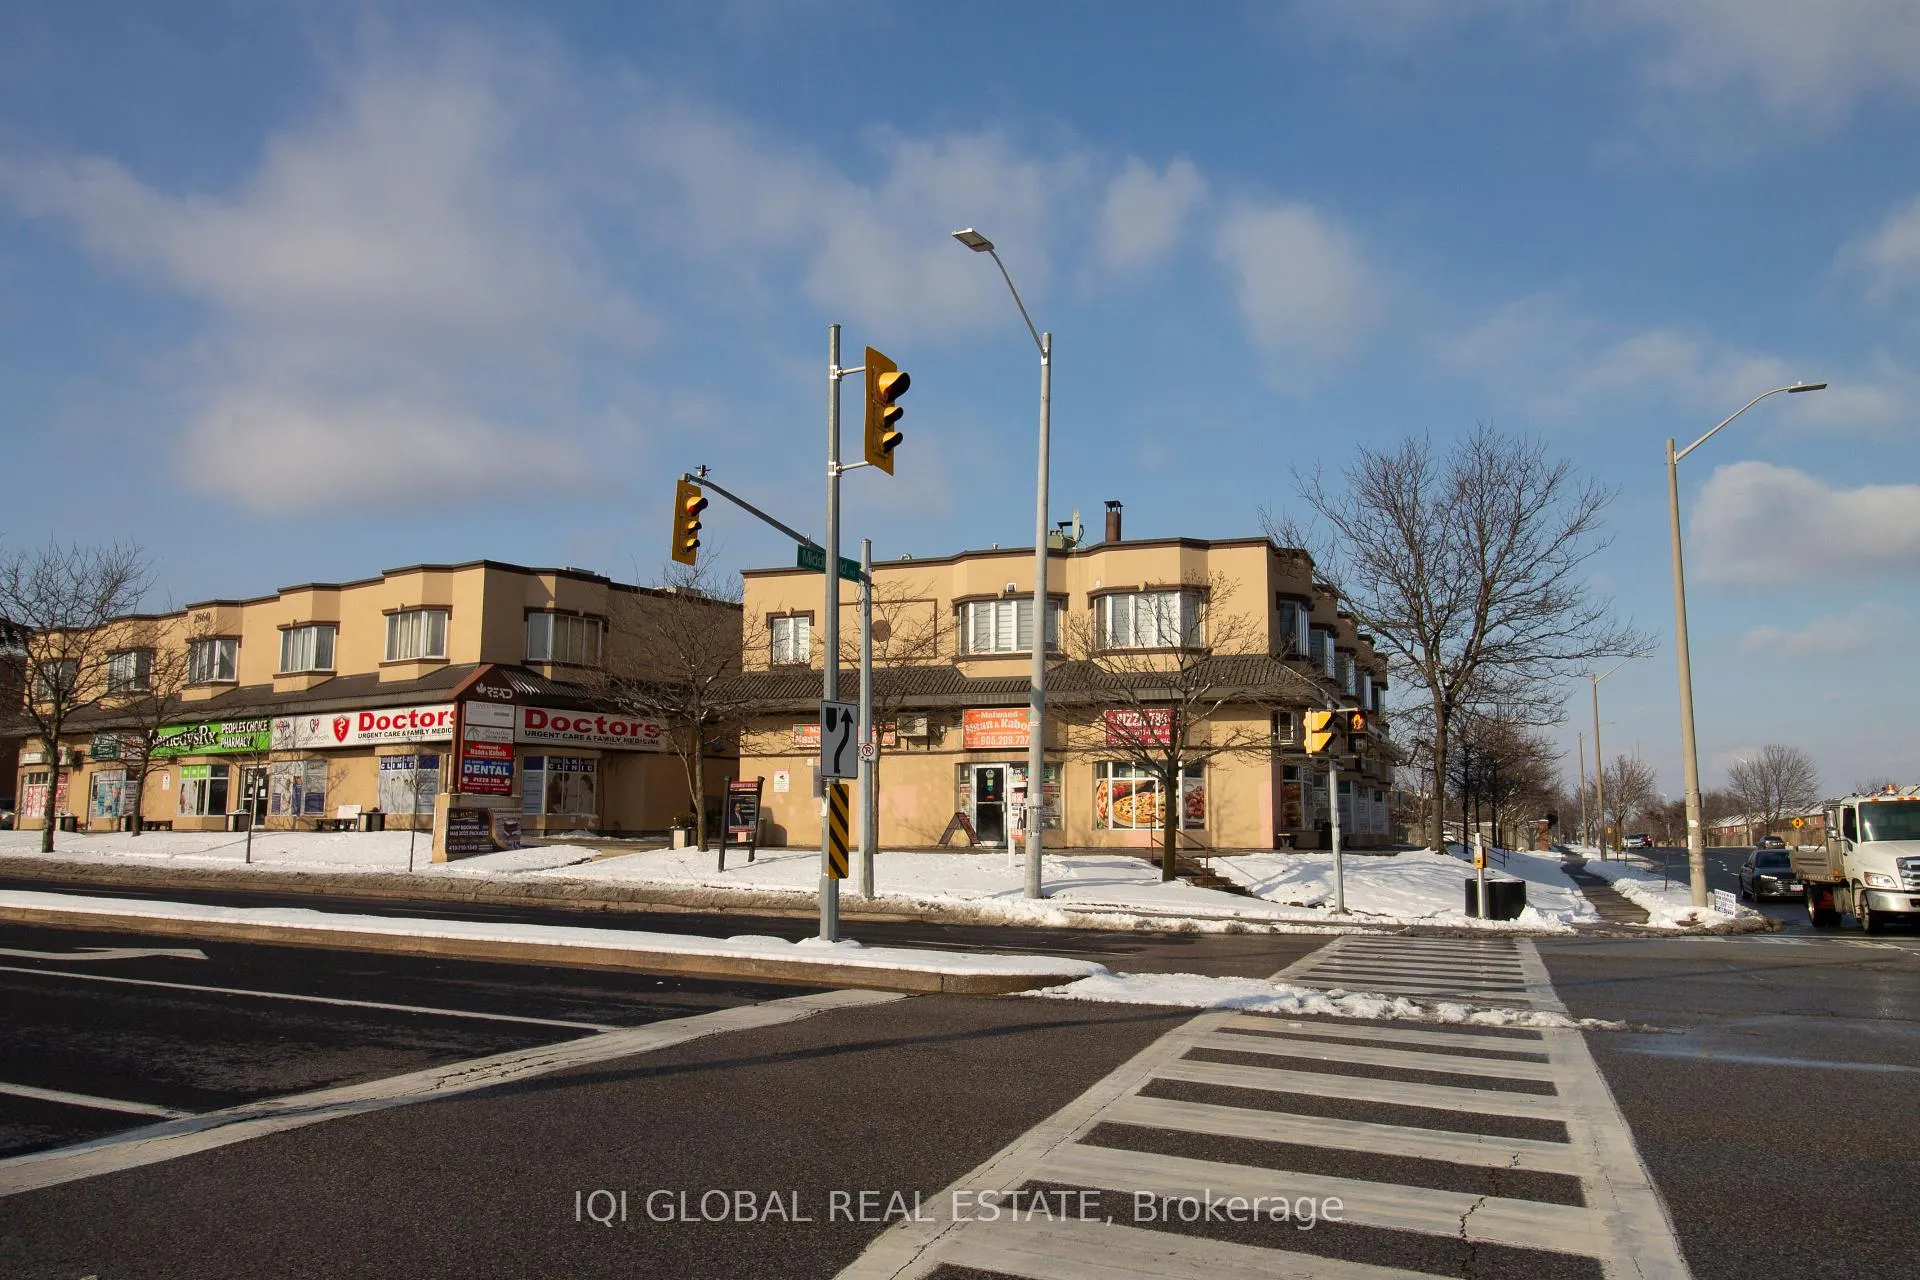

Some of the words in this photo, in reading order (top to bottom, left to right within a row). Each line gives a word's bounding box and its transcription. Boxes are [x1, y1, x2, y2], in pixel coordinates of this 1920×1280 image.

[524, 708, 661, 739] Doctors
[357, 731, 383, 740] URGENT
[384, 730, 401, 738] CARE
[407, 728, 430, 737] FAMILY
[431, 727, 453, 735] MEDIC
[524, 730, 561, 739] URGENT
[562, 733, 585, 741] CARE
[593, 735, 622, 743] FAMILY
[220, 736, 251, 748] PHARMACY
[381, 761, 414, 770] CLINIC
[464, 763, 509, 776] DENTAL
[548, 763, 593, 771] CLINIC
